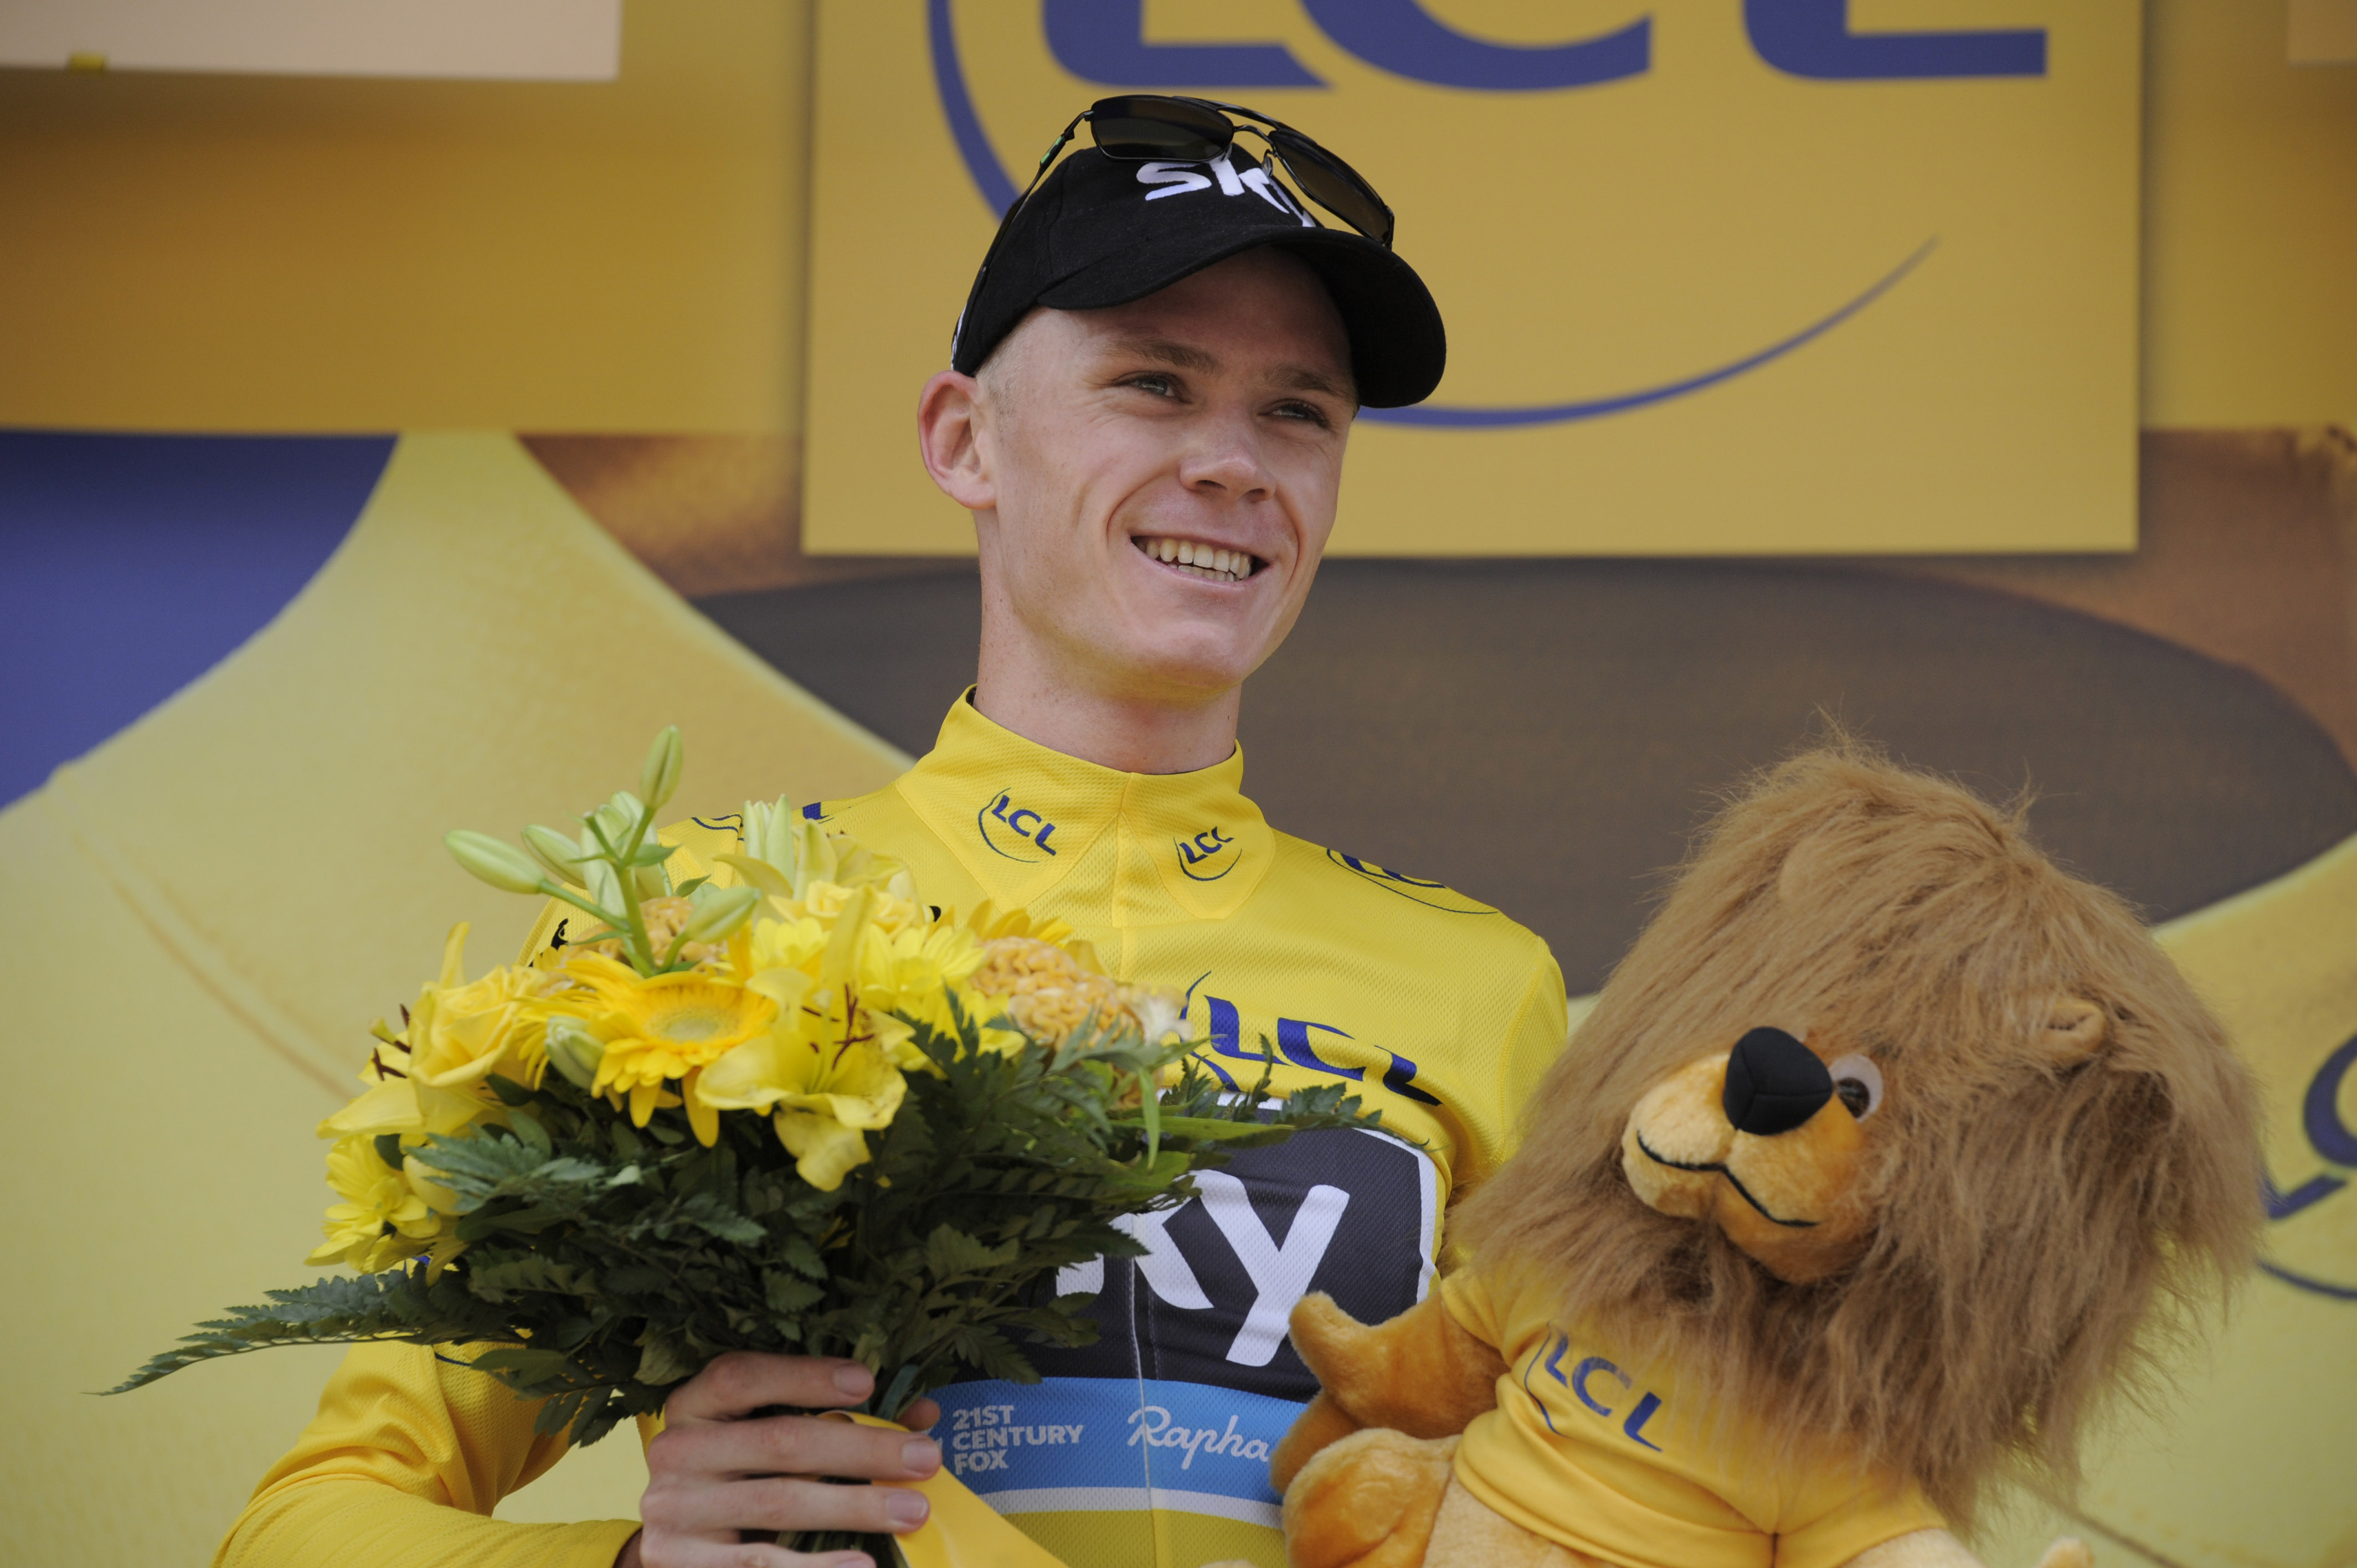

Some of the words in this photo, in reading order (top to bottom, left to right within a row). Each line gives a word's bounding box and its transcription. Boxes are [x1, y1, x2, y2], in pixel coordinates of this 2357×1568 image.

[991, 795, 1057, 856] LCL
[1179, 826, 1234, 864] LCL
[1203, 994, 1444, 1106] LCL
[1545, 1331, 1664, 1453] LCL
[952, 1405, 1015, 1431] 21ST
[952, 1425, 1084, 1451] CENTURY
[1126, 1405, 1269, 1470] Rapha
[954, 1449, 1008, 1475] FOX
